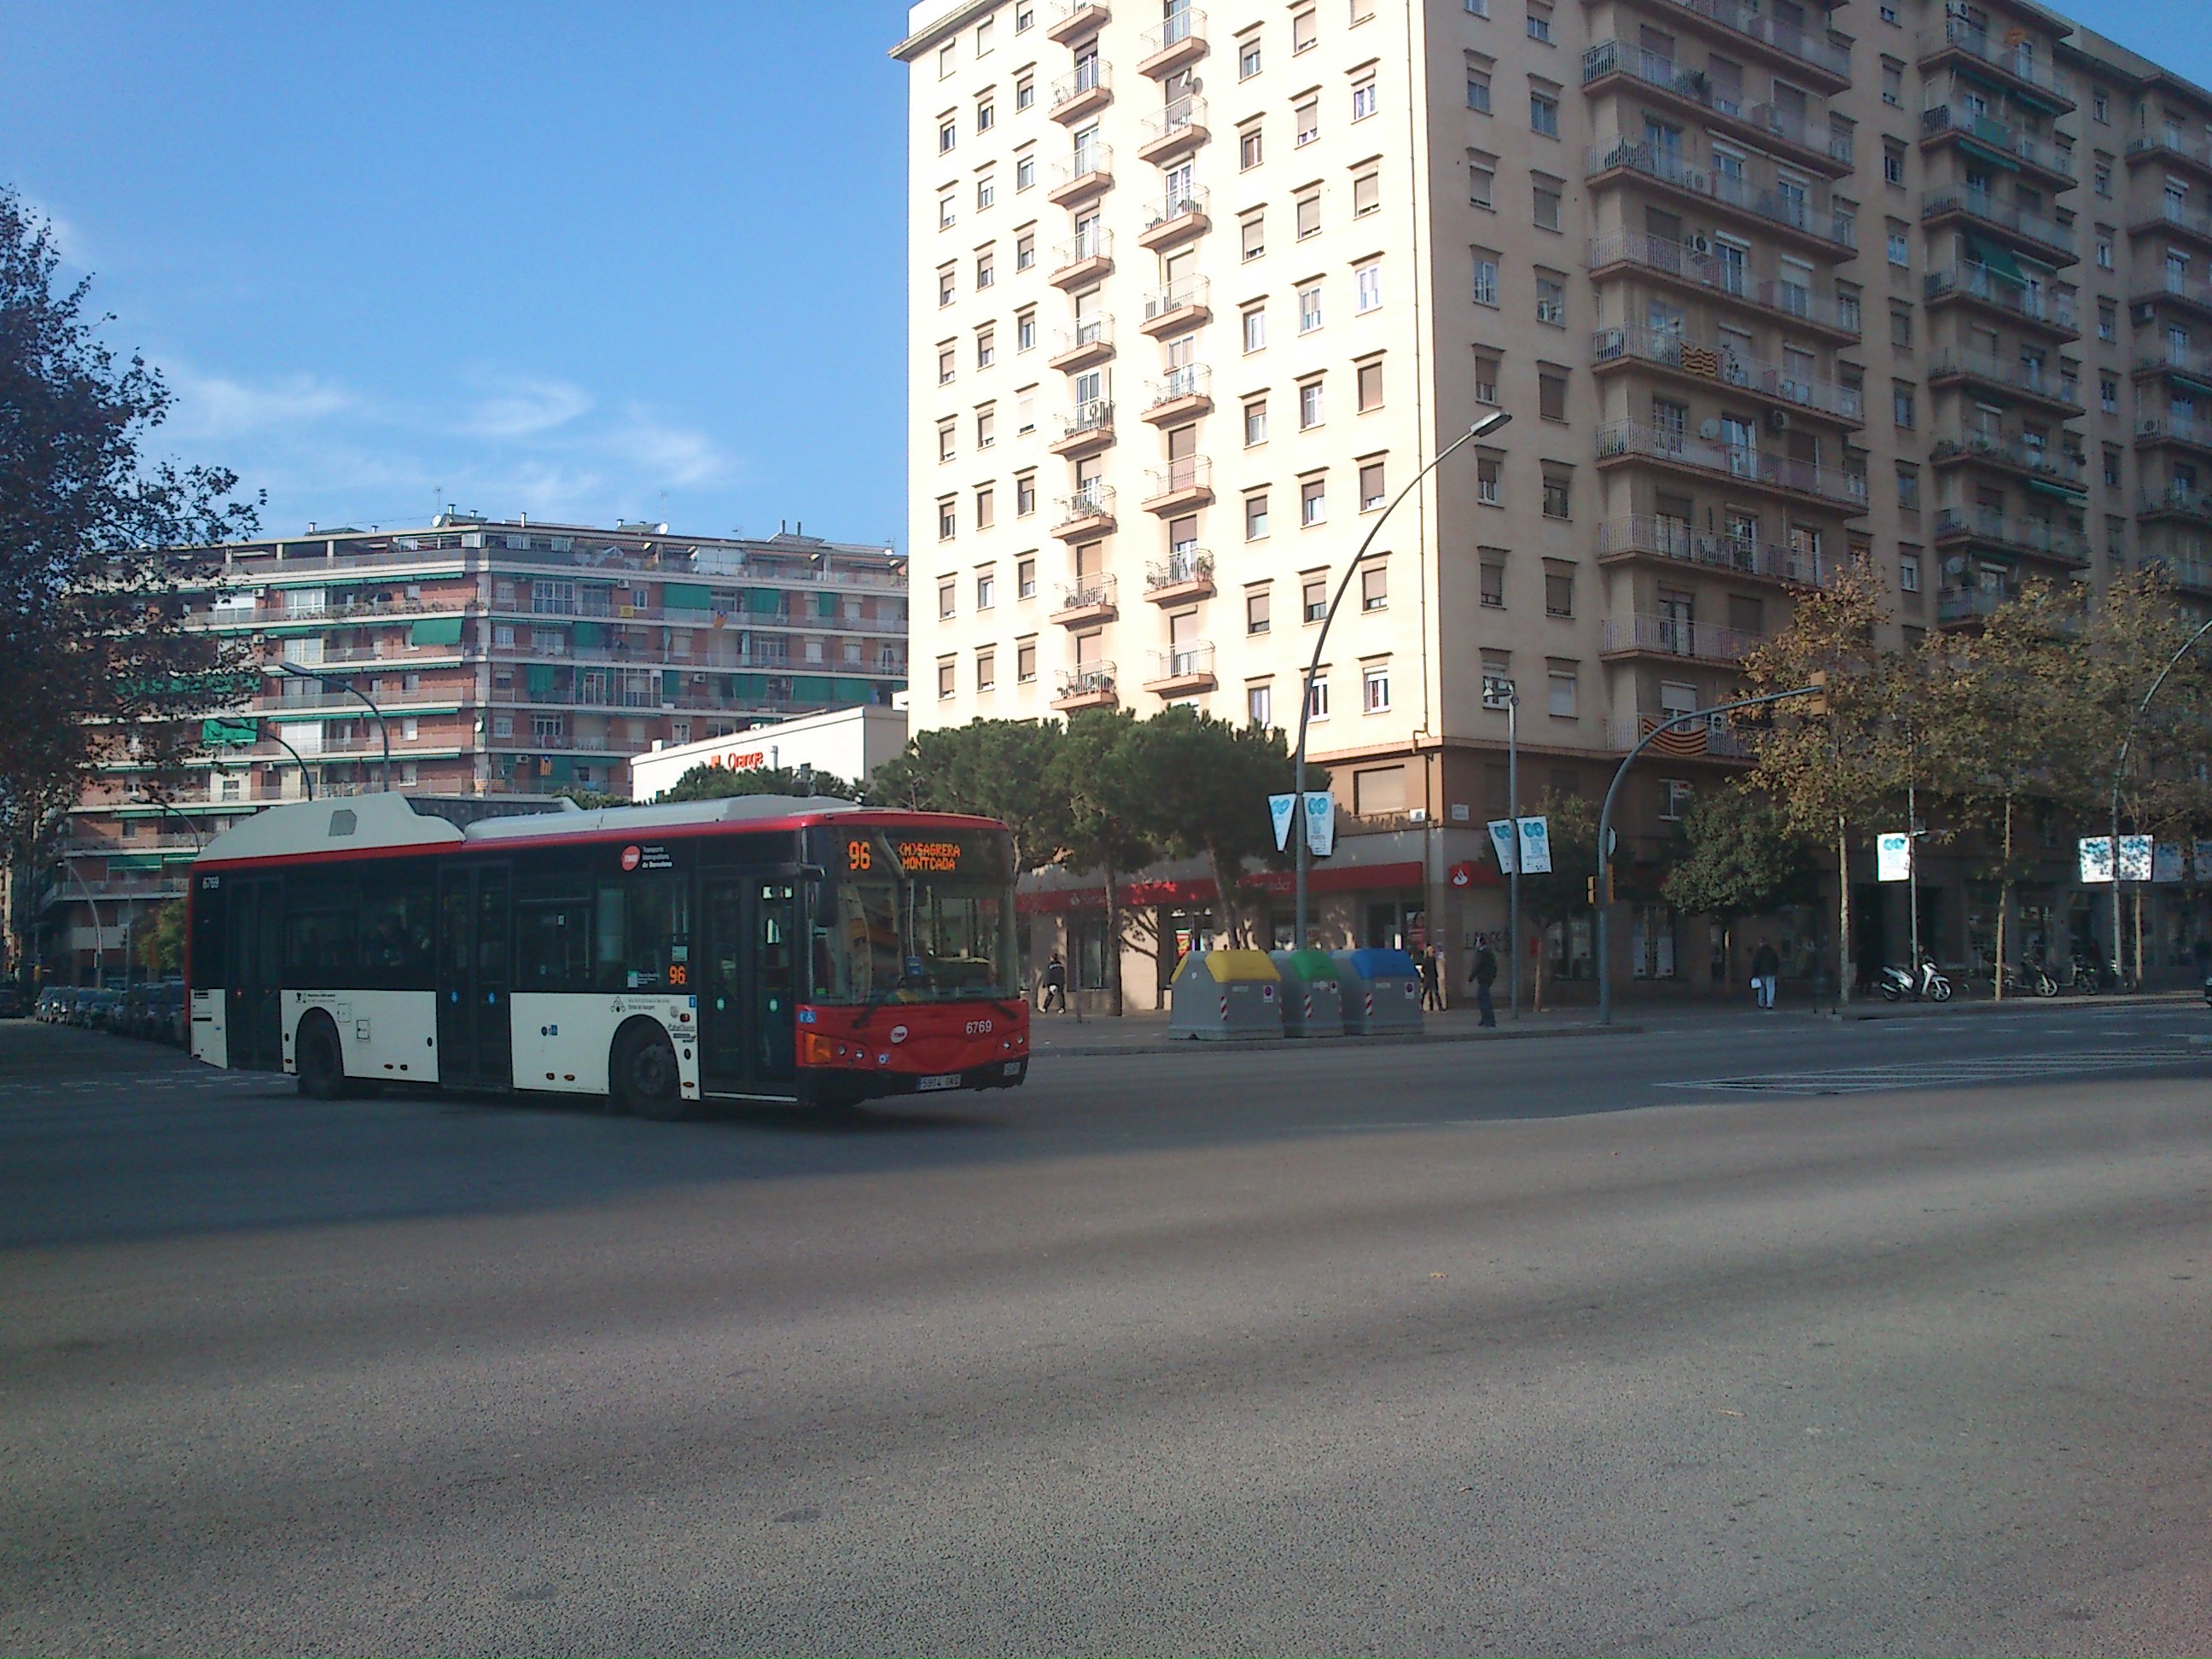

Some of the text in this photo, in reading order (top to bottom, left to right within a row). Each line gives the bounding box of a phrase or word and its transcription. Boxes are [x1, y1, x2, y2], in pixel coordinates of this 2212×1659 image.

[728, 752, 763, 771] Orange
[849, 841, 870, 870] 96
[902, 856, 956, 870] MONTCADA
[669, 965, 686, 985] 96
[966, 1020, 992, 1034] 6769
